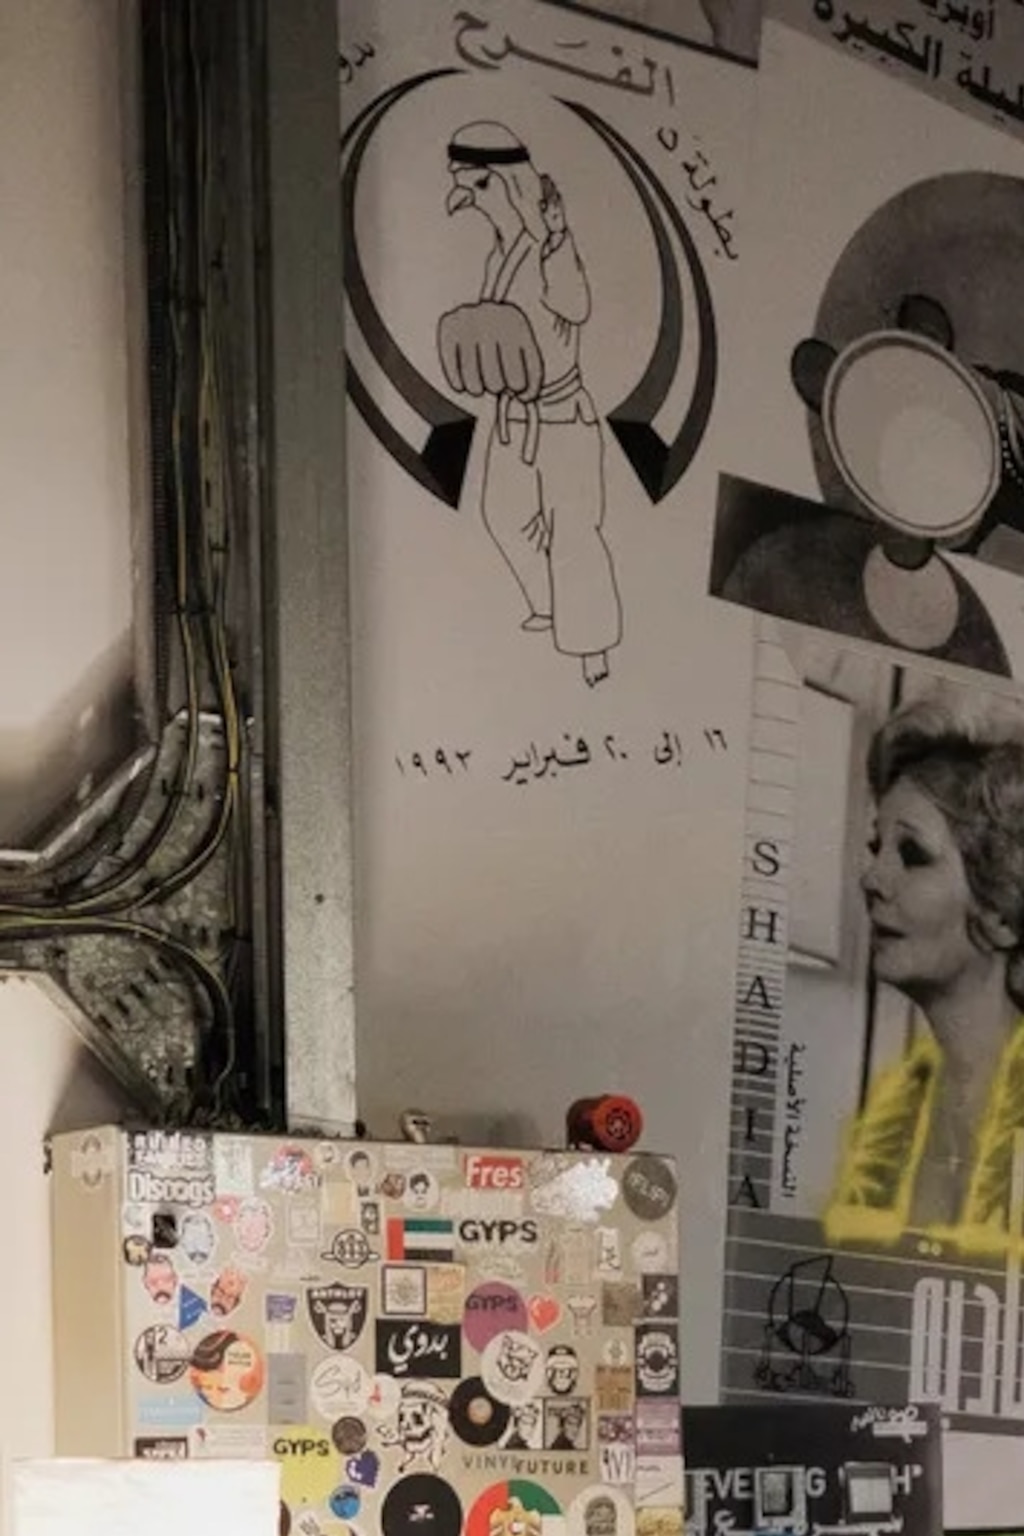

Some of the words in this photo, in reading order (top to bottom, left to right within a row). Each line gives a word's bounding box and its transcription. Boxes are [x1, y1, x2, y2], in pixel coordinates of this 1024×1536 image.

[500, 732, 593, 787] فبراير
[459, 1219, 538, 1243] GYPS
[273, 1438, 330, 1456] GYPS
